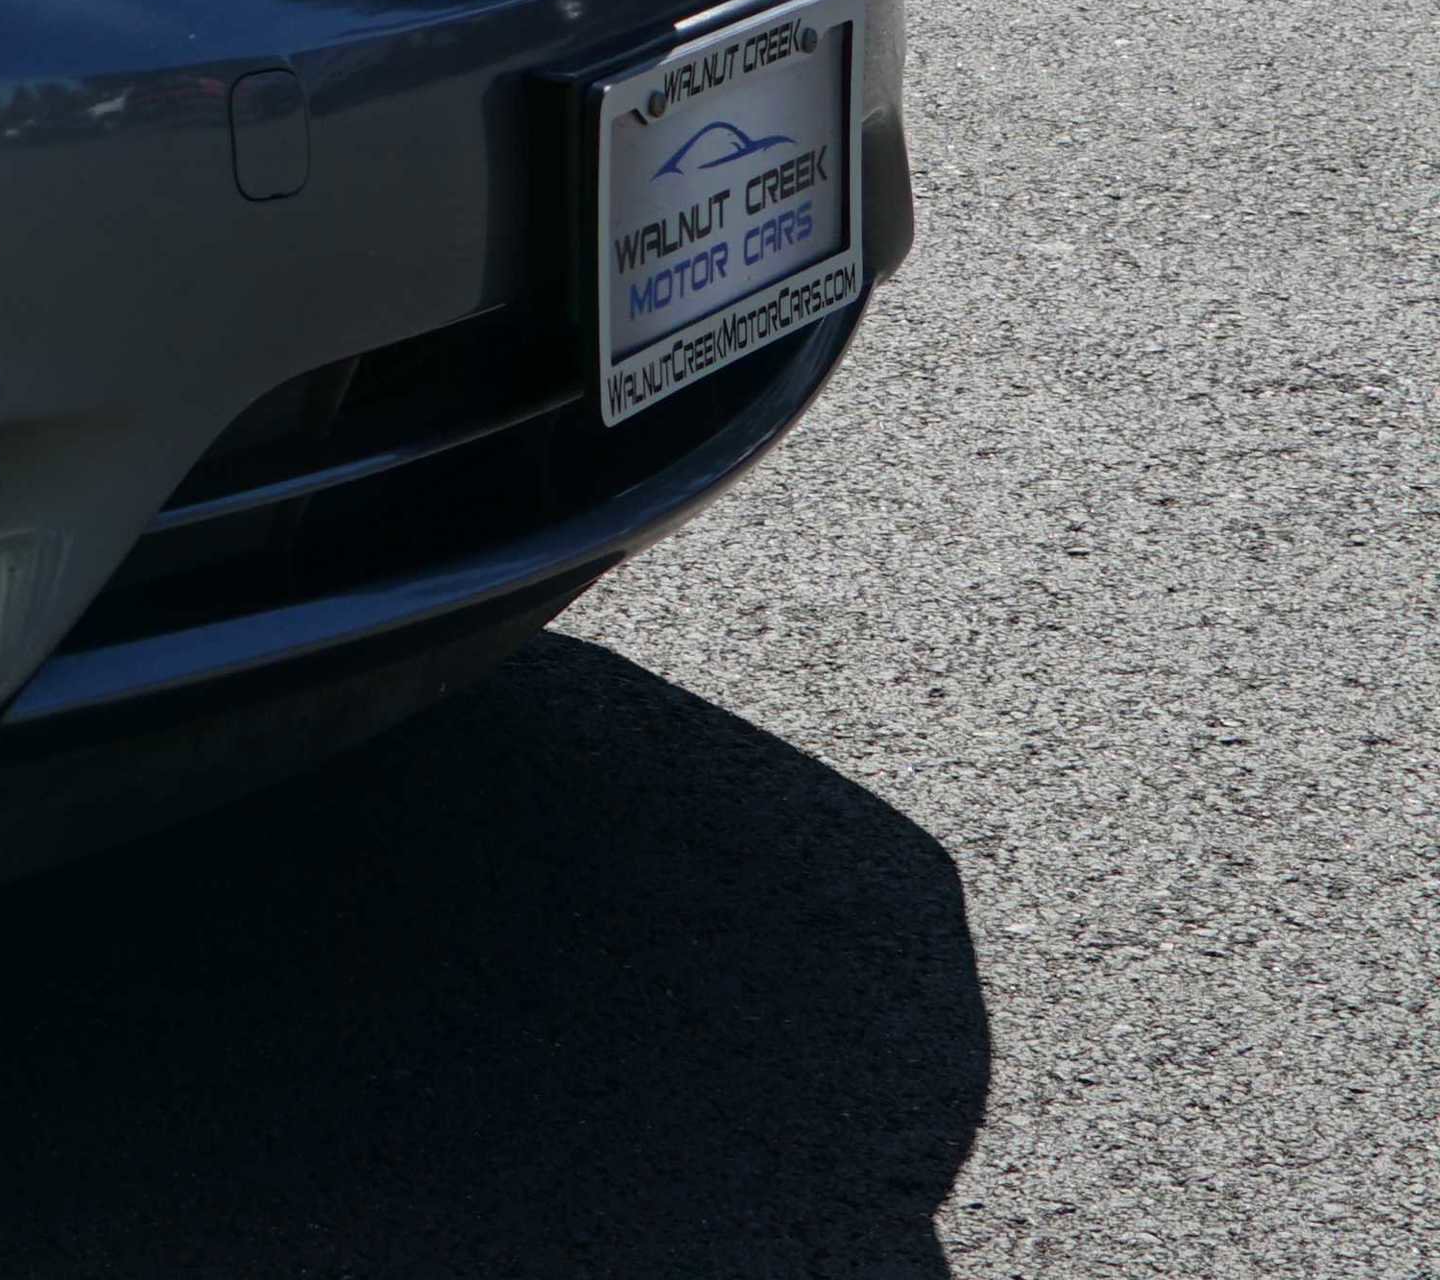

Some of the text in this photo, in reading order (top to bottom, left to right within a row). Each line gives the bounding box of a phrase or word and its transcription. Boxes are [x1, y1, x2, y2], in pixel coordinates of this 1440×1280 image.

[663, 18, 802, 107] WALNUT CREEK
[615, 146, 827, 274] WALNUT CREEK
[628, 202, 814, 321] MOTOR CARS
